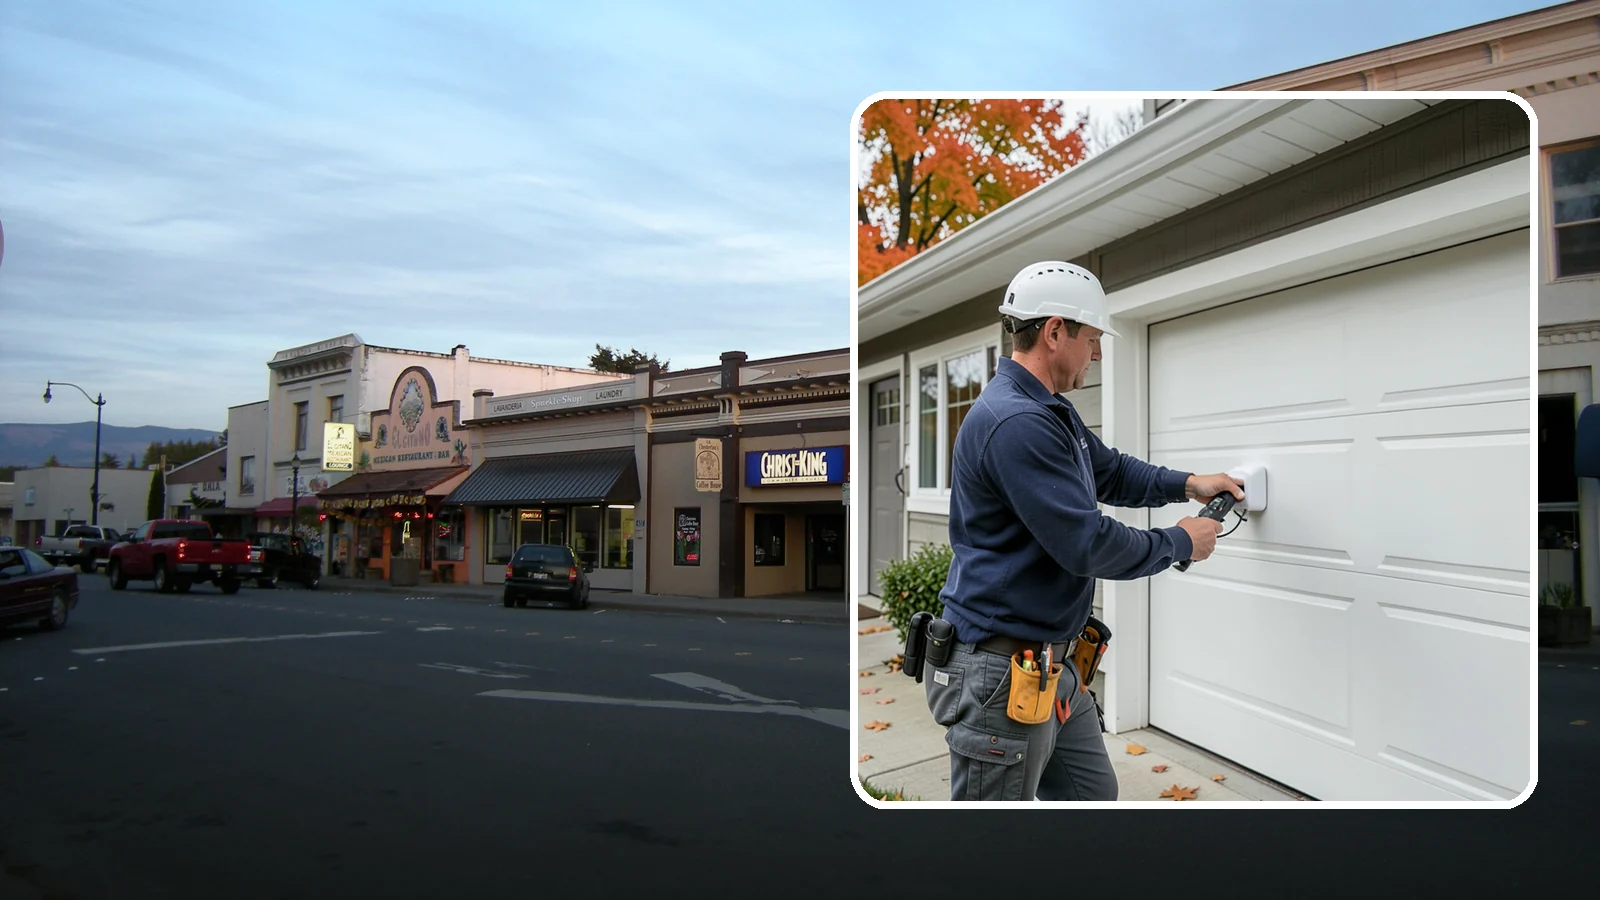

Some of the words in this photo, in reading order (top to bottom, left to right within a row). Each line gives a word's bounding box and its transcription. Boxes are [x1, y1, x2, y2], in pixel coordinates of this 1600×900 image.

[530, 396, 561, 408] Sparkle
[562, 394, 583, 406] Shop
[595, 389, 624, 400] LAUNDRY
[493, 402, 523, 412] LAVANDERIA
[373, 455, 396, 464] MEXICAN
[397, 451, 433, 462] RESTAURANT
[437, 450, 450, 459] BAR
[760, 452, 797, 478] CHRIST
[799, 450, 828, 476] KING
